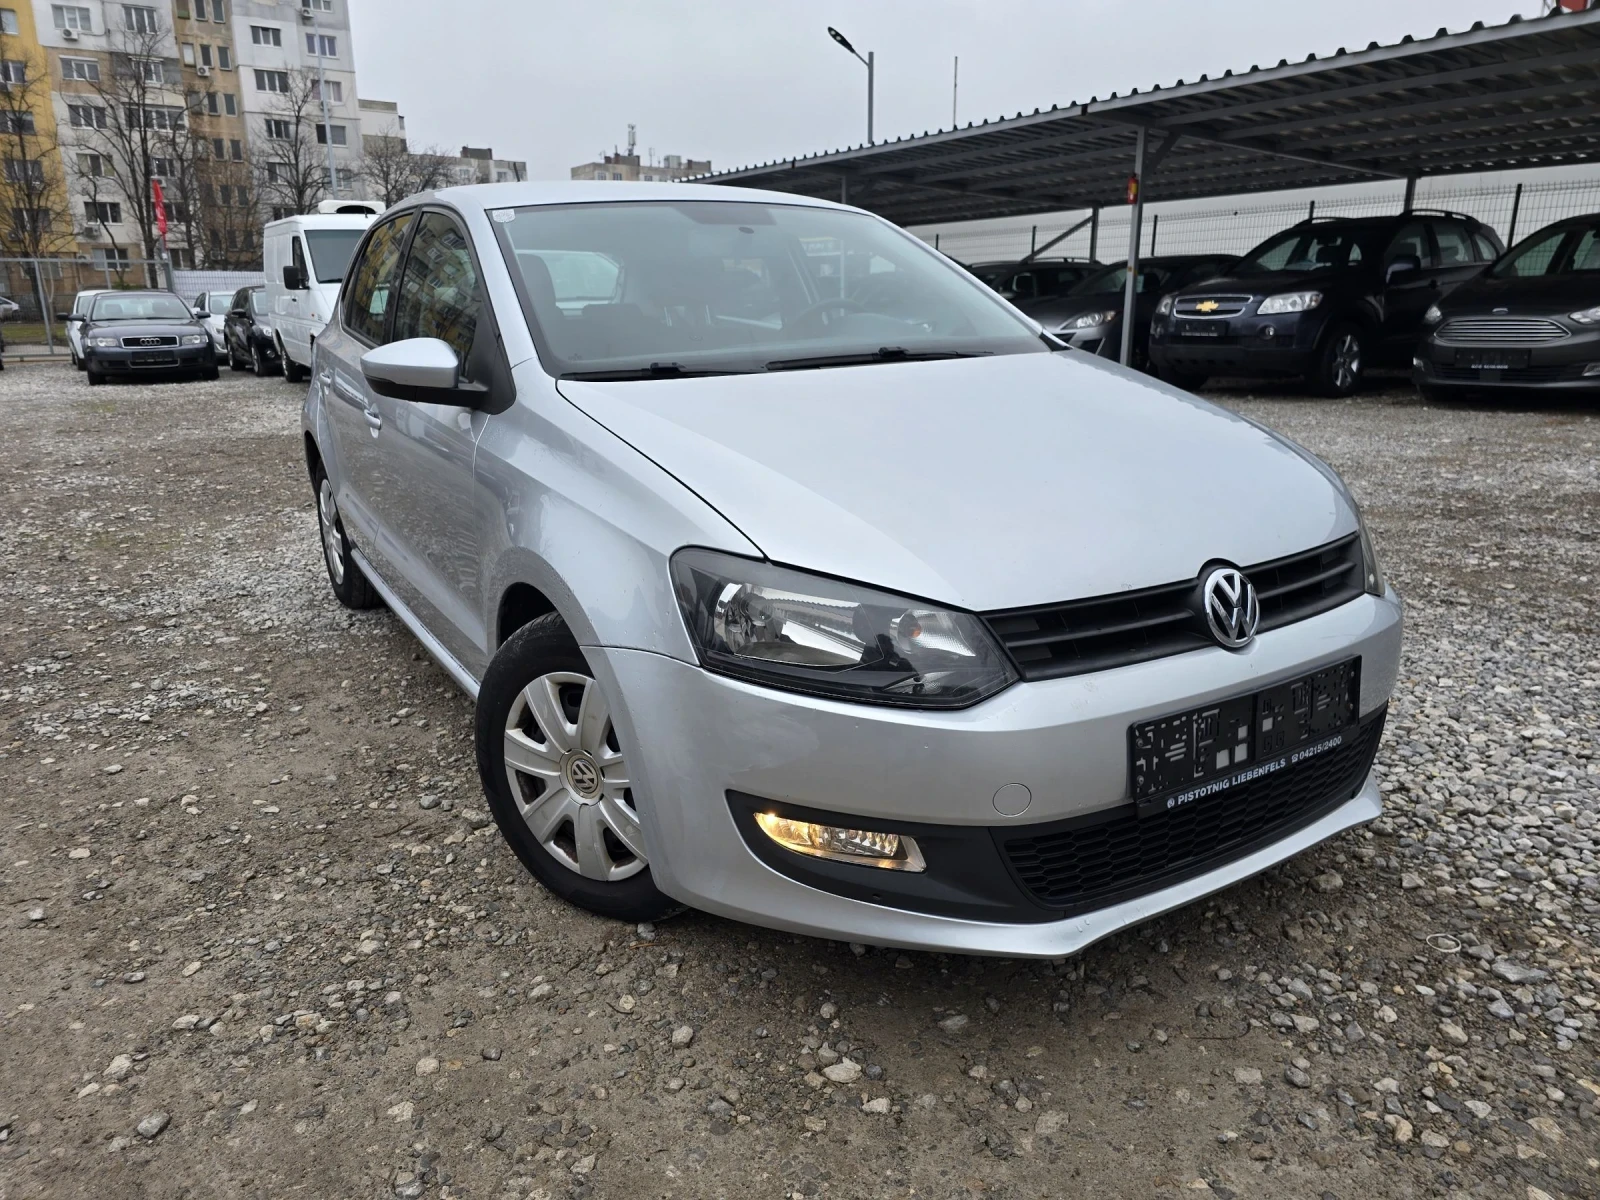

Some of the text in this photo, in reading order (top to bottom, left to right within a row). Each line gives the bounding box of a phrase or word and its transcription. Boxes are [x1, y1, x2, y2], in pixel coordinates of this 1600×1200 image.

[1205, 568, 1260, 647] VW
[1177, 735, 1342, 805] PISTOTNIG LIEBENFELS 04215/2400
